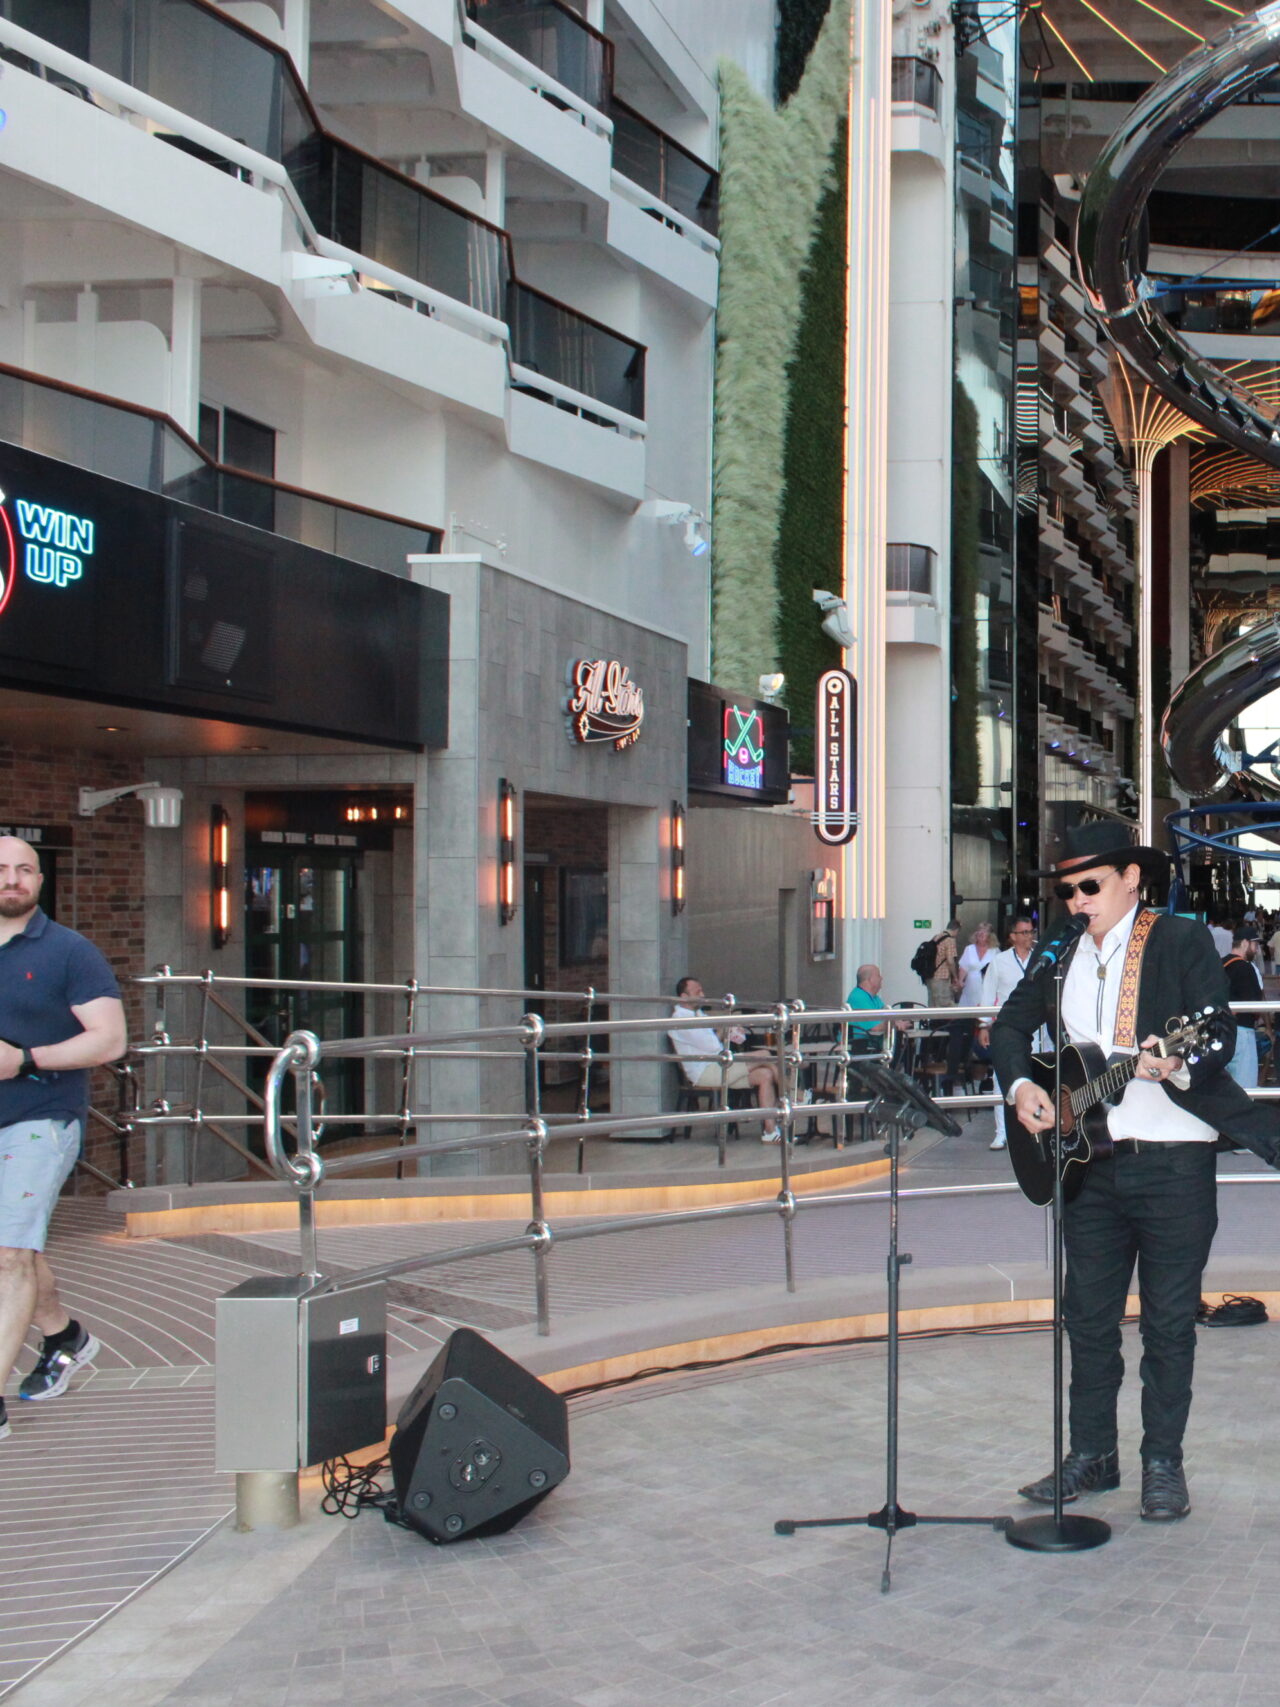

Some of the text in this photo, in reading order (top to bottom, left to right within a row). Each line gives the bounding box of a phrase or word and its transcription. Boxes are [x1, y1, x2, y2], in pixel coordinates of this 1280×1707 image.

[16, 499, 94, 554] WIN
[26, 543, 83, 587] UP
[727, 759, 761, 789] HOCKEY
[829, 696, 840, 809] ALL STARS
